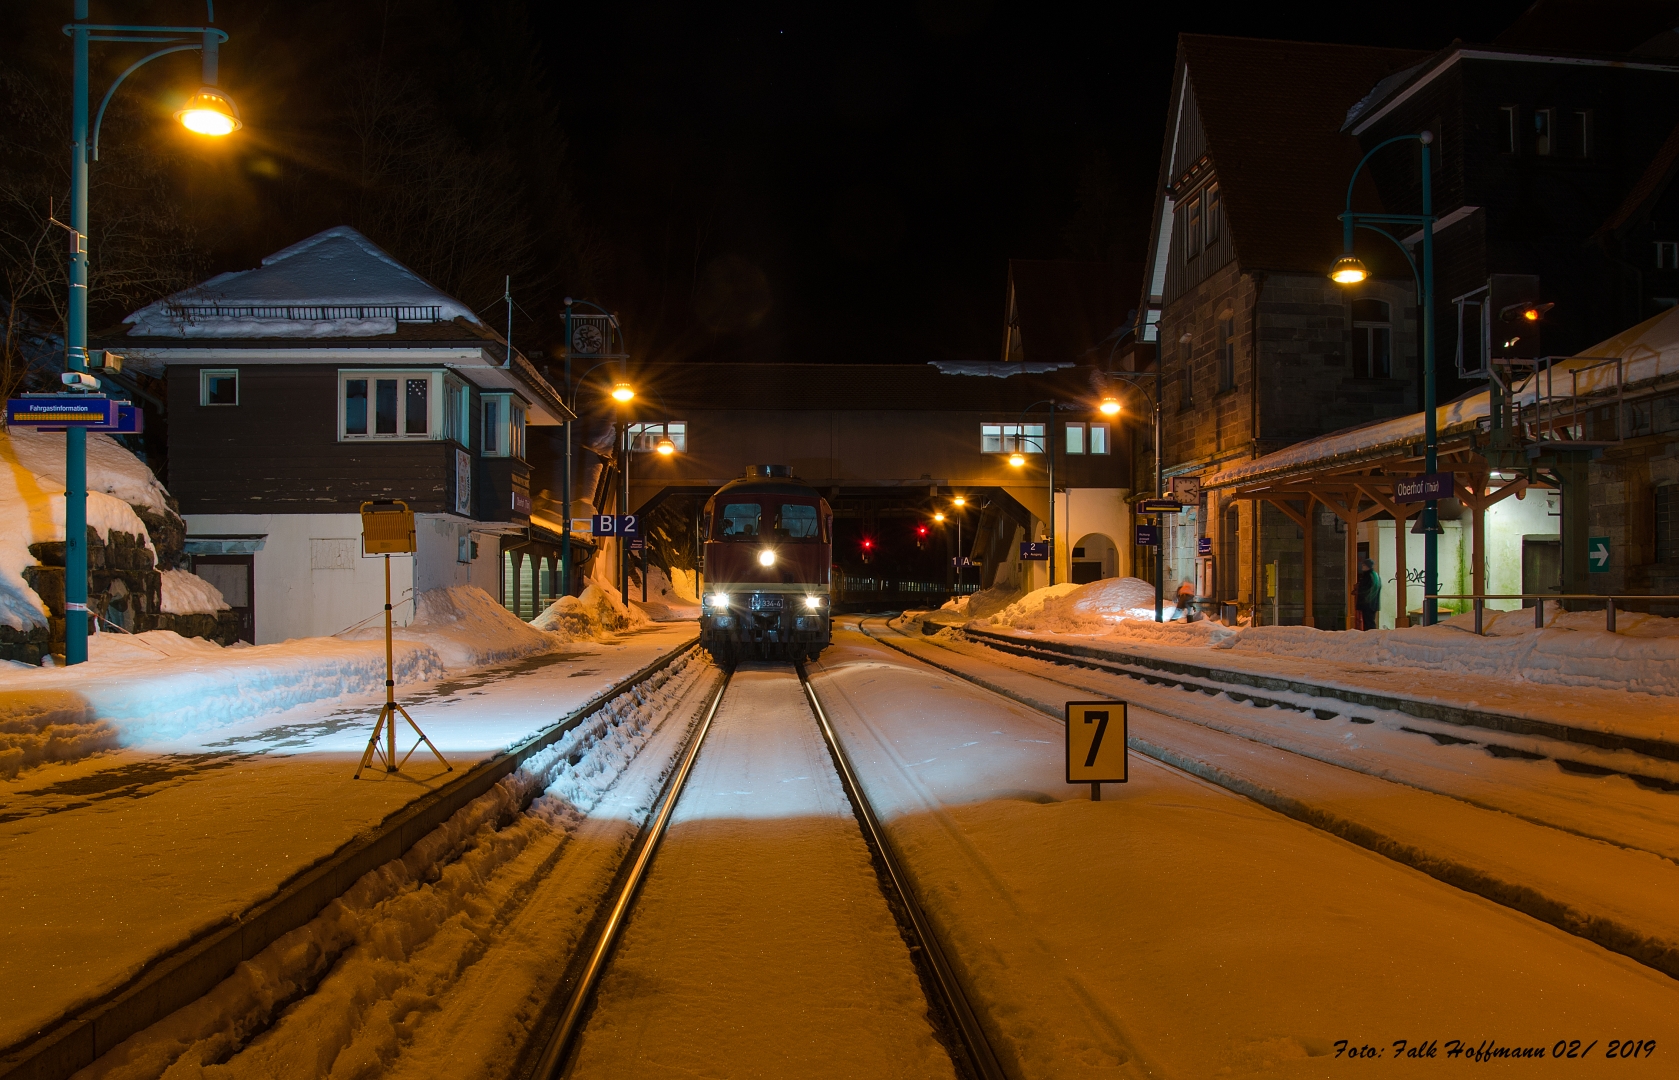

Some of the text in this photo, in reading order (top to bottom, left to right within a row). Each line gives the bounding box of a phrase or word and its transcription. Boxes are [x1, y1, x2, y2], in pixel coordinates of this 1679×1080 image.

[29, 405, 89, 413] Fahrgastinformation
[1397, 480, 1424, 496] Oberhof
[600, 515, 613, 532] B
[624, 515, 636, 532] 2
[1030, 542, 1036, 551] 2
[952, 557, 957, 566] 1
[962, 557, 970, 566] A
[1084, 710, 1109, 767] 7
